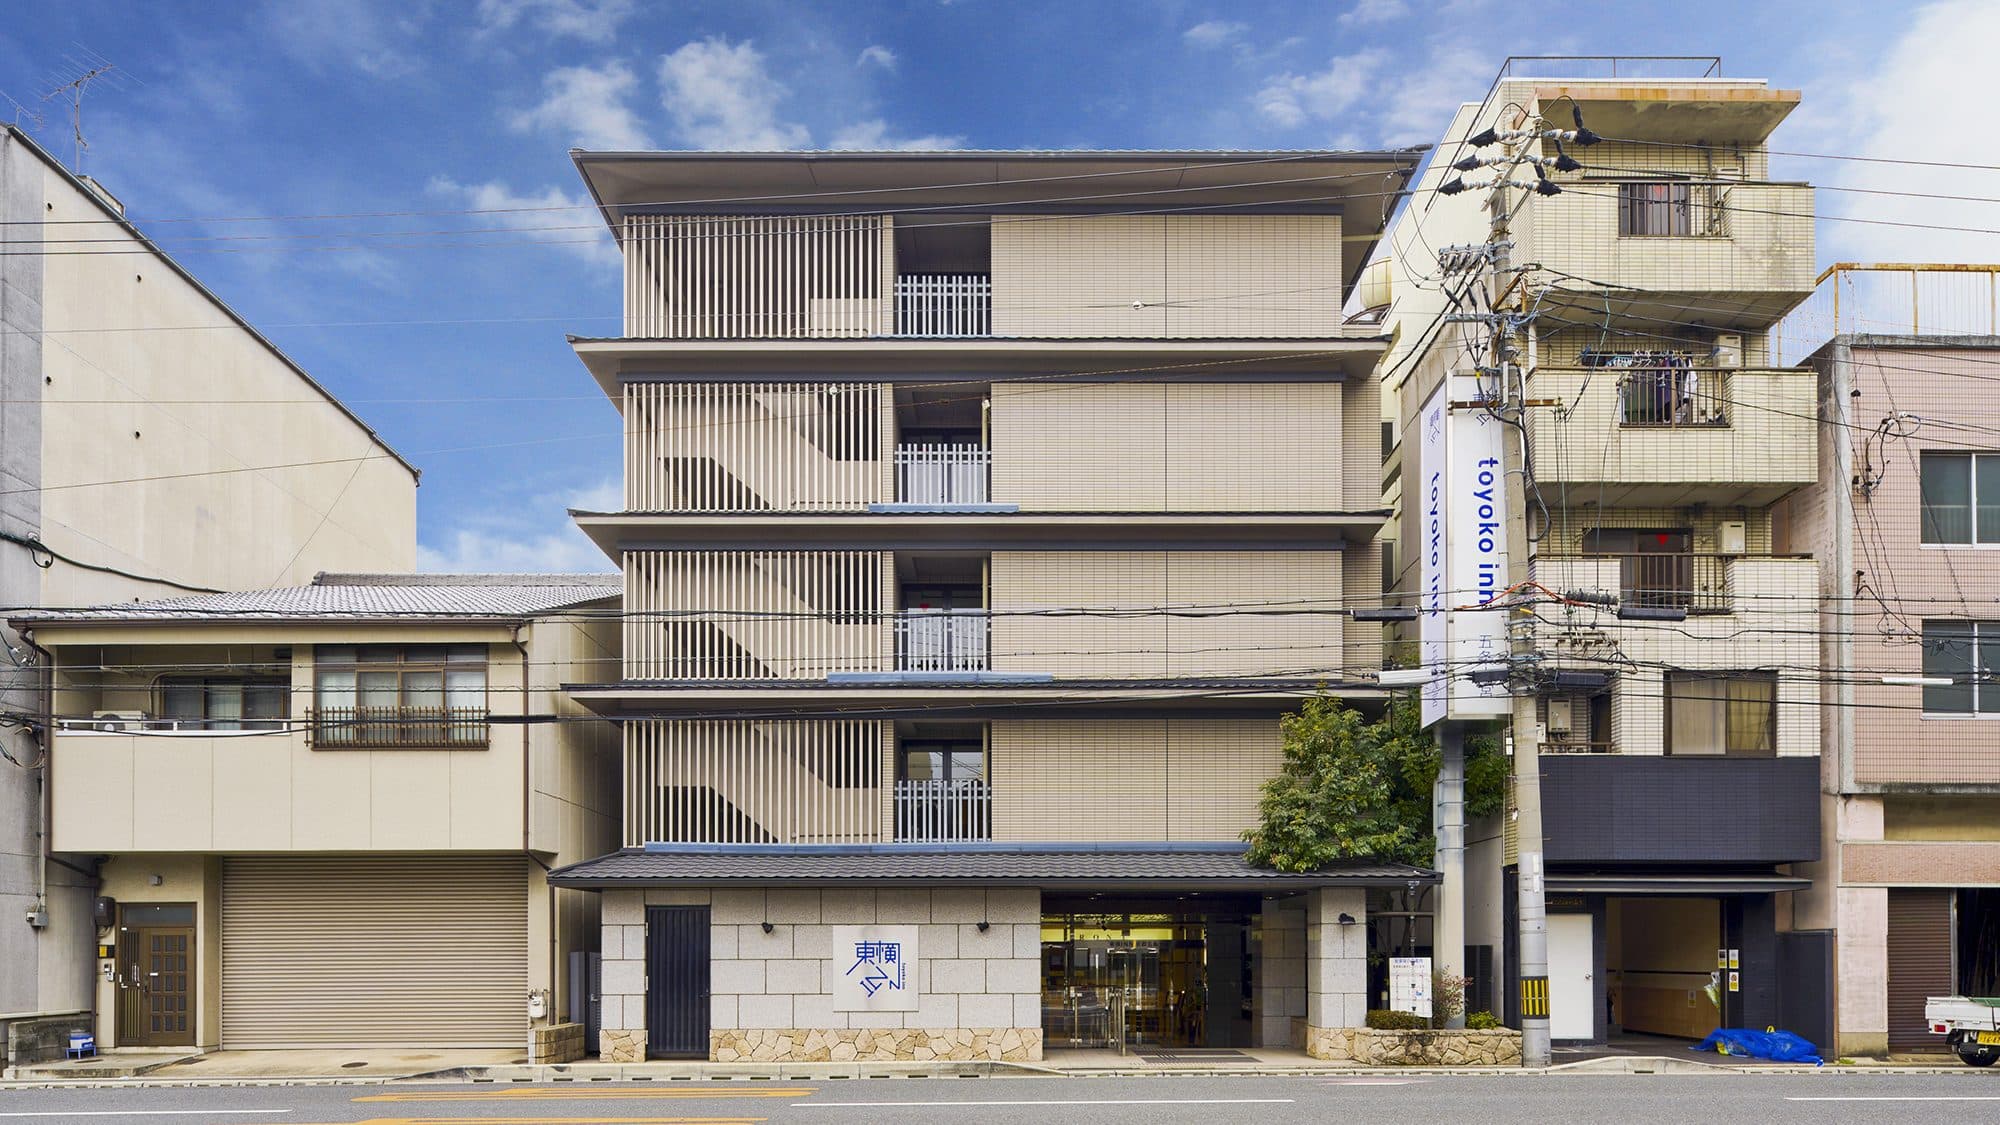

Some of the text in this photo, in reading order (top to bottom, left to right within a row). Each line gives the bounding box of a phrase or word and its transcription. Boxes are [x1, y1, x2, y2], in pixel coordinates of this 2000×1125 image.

[1429, 472, 1441, 617] toyoko inn
[1473, 457, 1500, 605] toyoko inn
